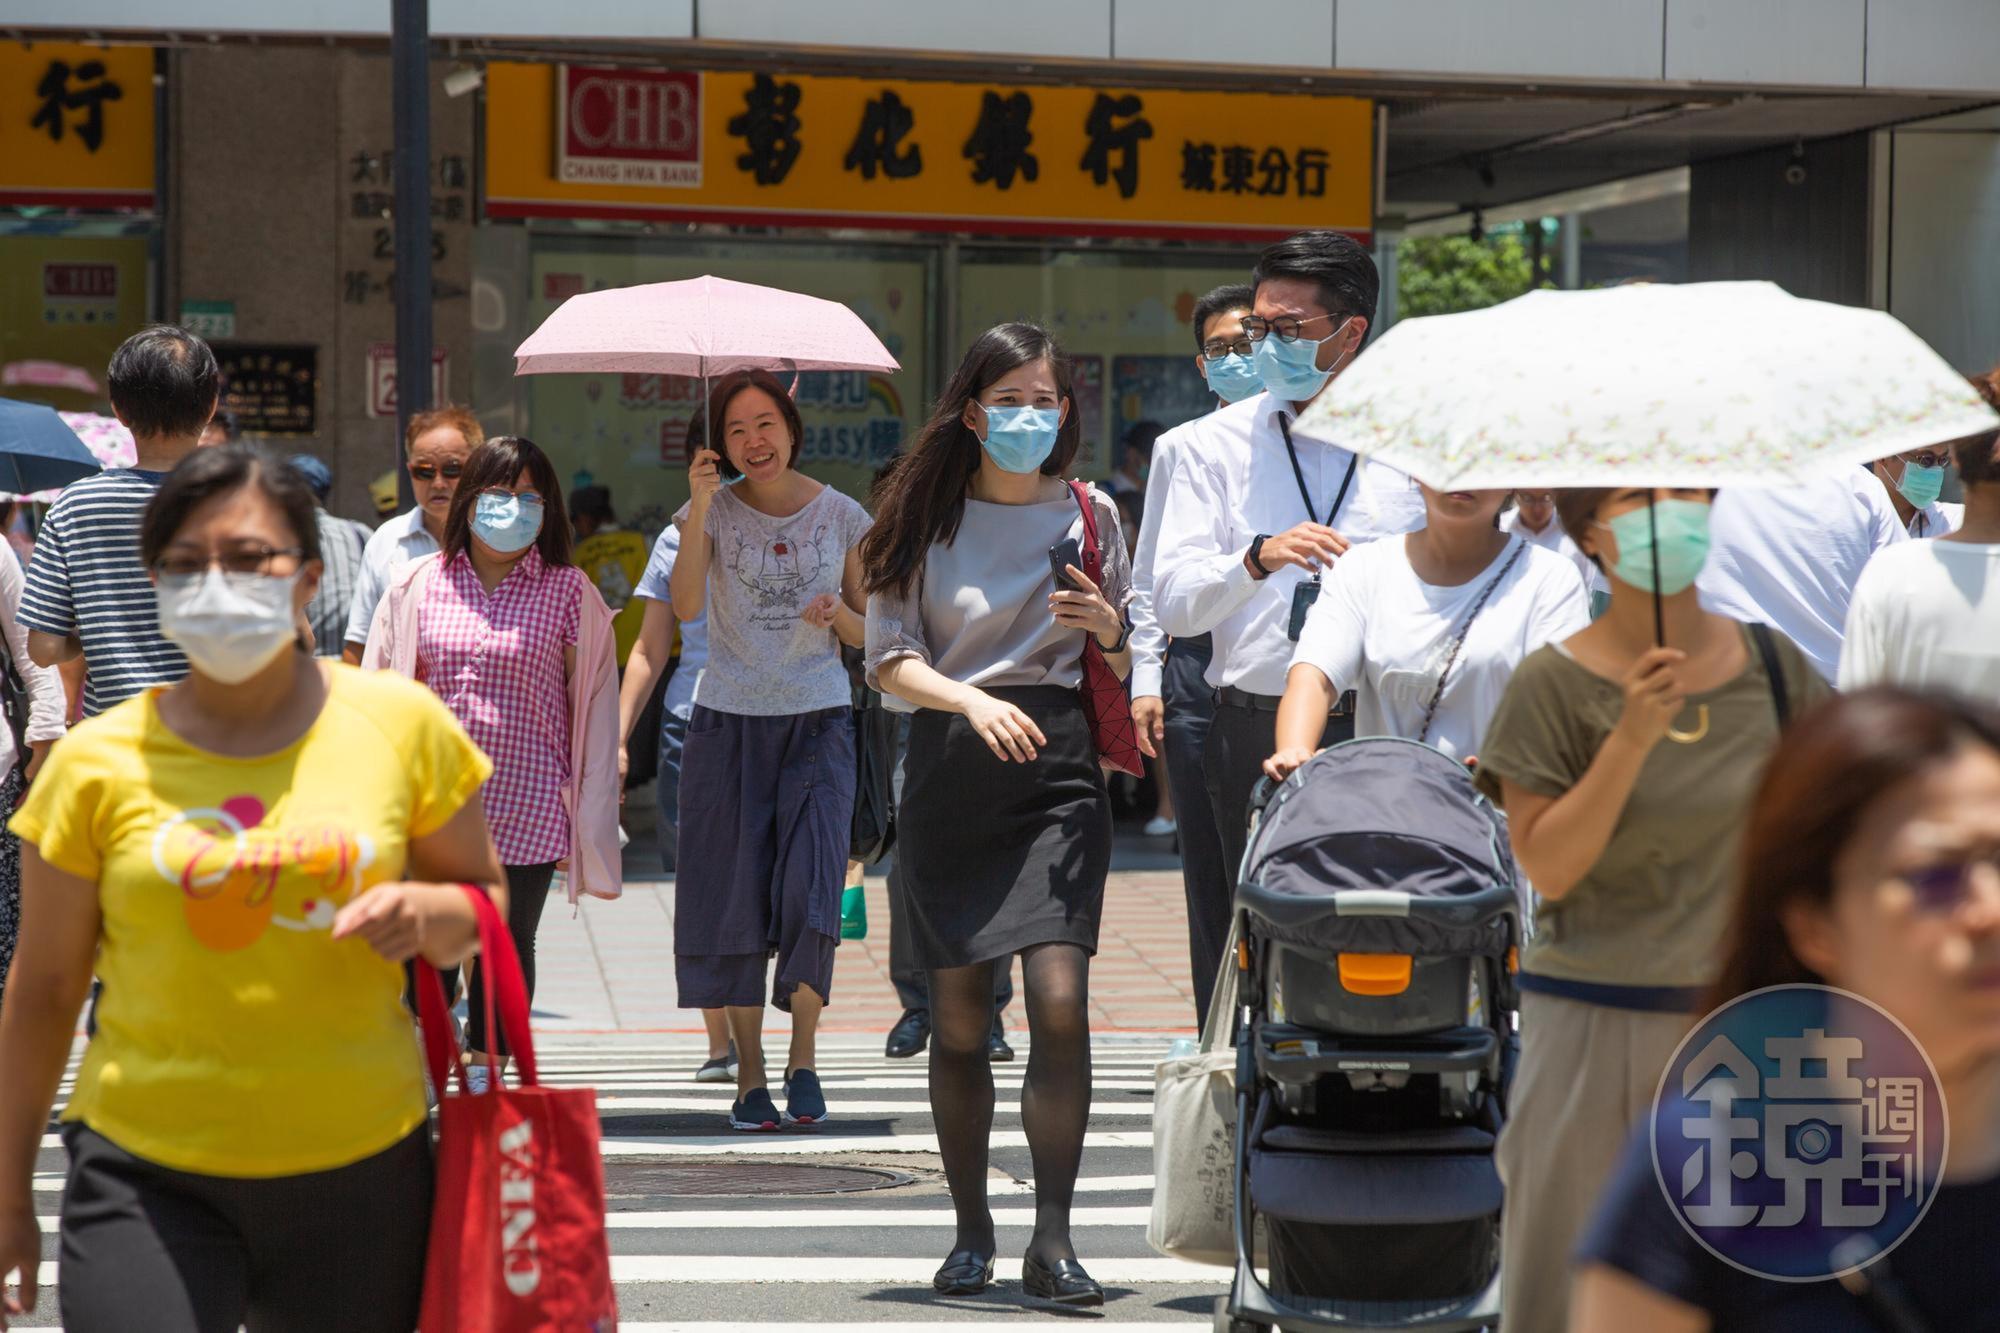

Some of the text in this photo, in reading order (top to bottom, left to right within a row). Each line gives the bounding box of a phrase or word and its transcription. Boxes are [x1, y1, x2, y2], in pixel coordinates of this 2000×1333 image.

[30, 60, 123, 154] 行
[570, 76, 694, 152] CHB
[726, 72, 1154, 199] 彰化銀行
[563, 162, 699, 184] CHANG HWA BANK
[1180, 139, 1331, 198] 城東分行
